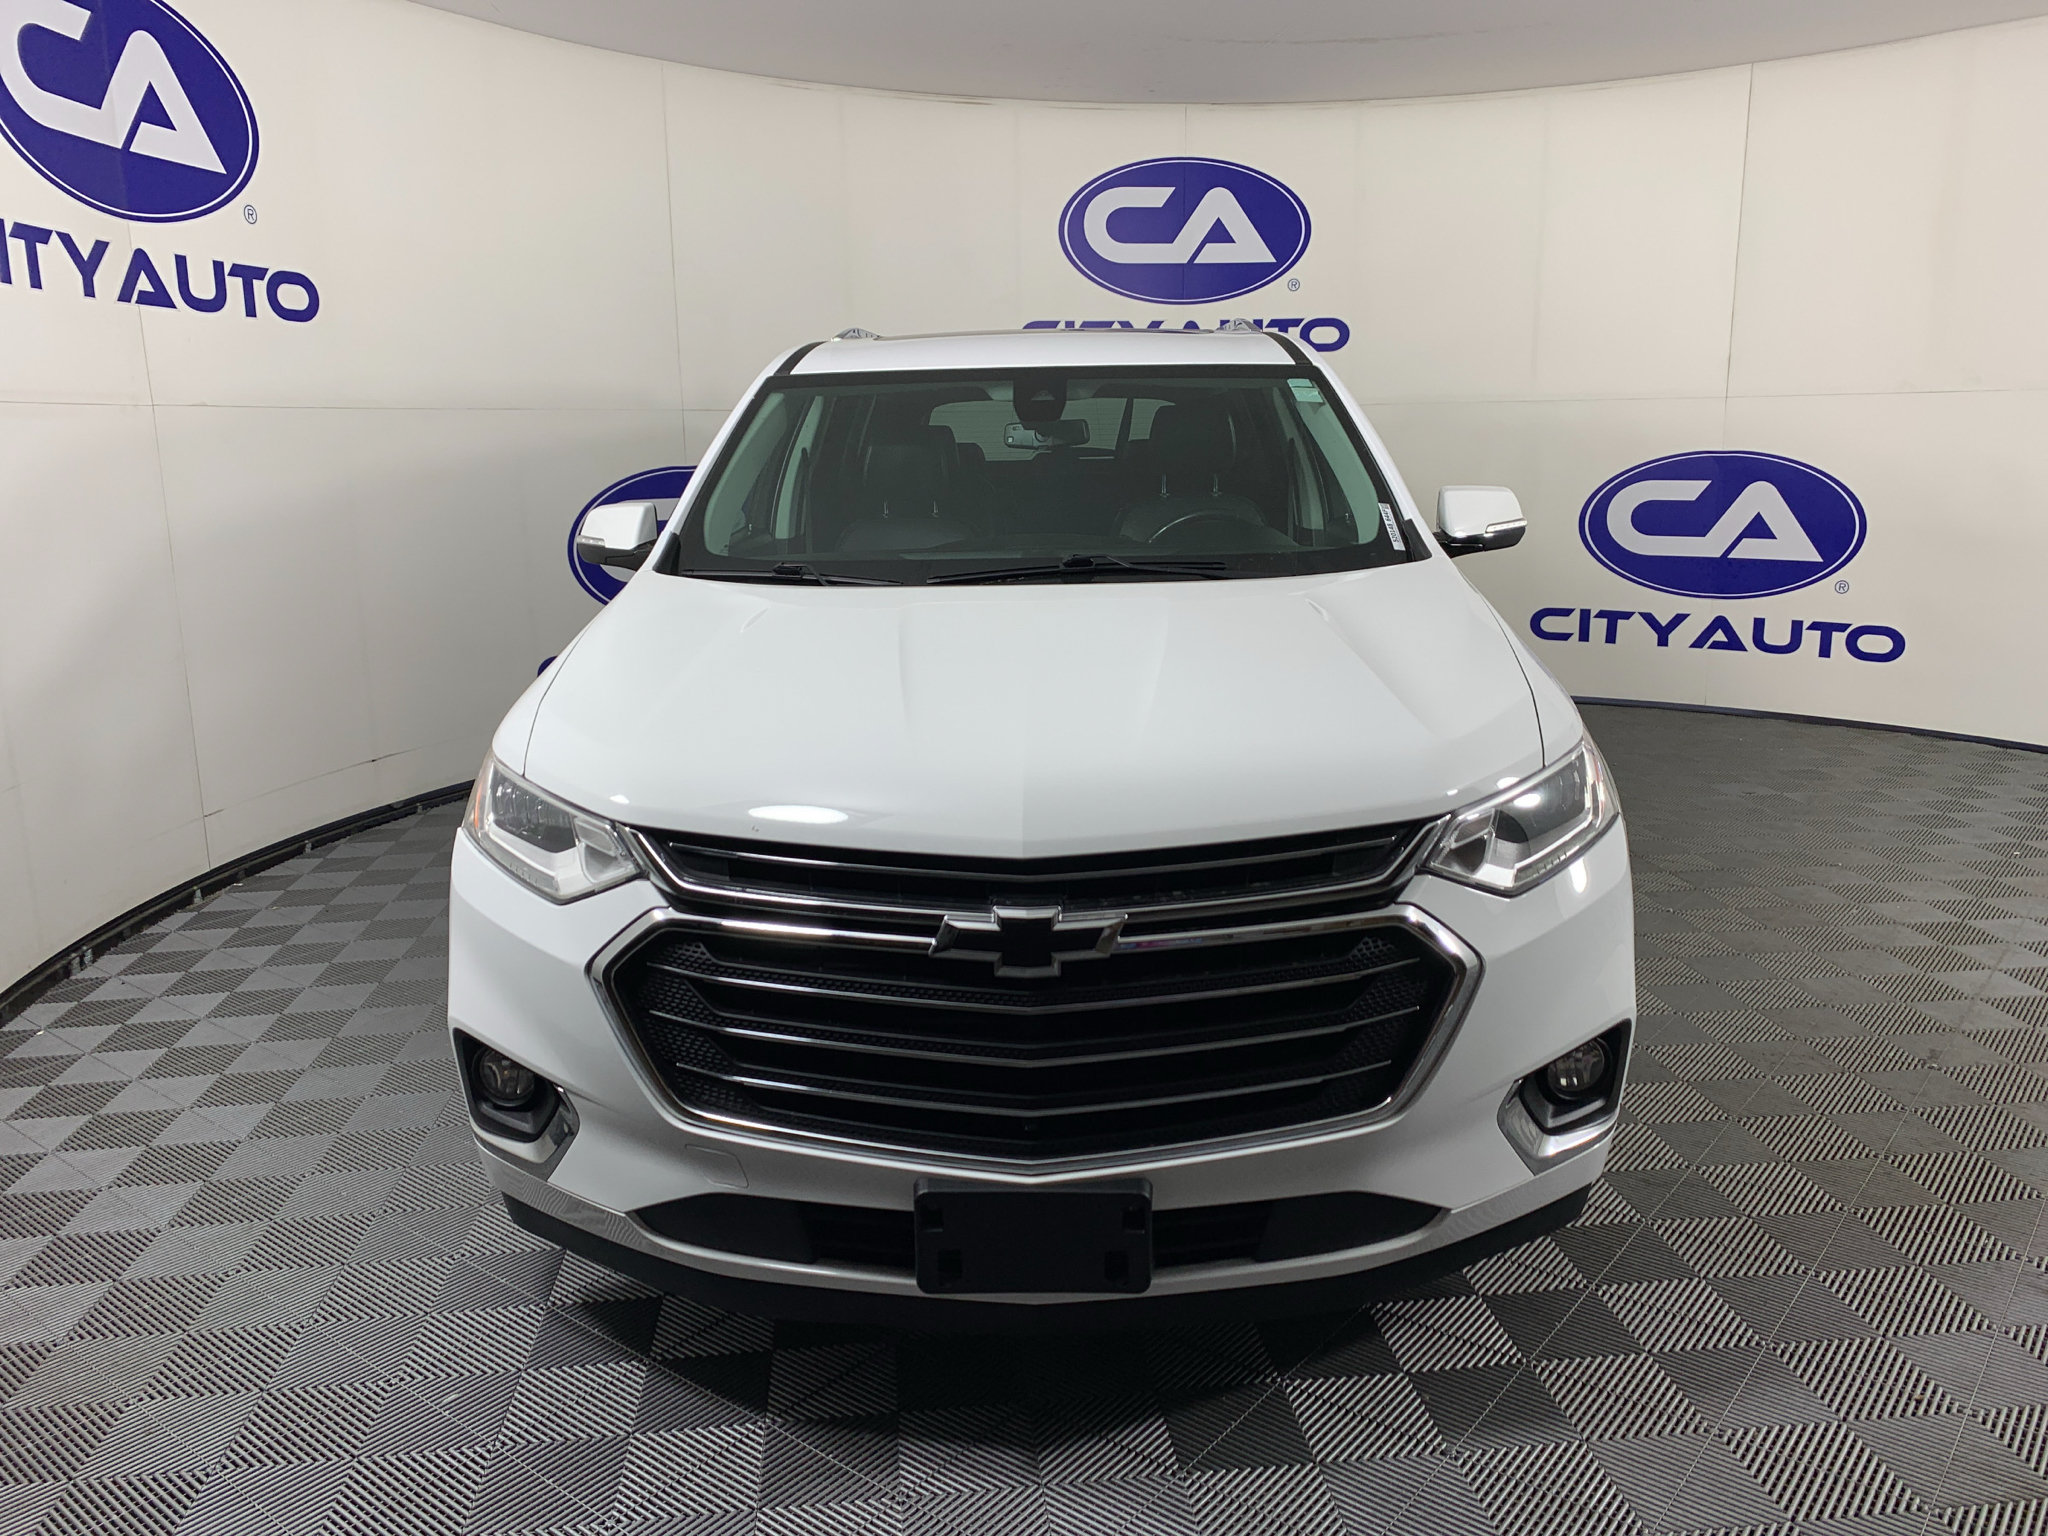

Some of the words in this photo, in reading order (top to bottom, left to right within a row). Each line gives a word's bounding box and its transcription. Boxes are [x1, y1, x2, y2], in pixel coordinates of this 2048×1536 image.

[0, 0, 228, 175] CA
[1083, 186, 1277, 264] CA
[116, 247, 320, 323] AUTO
[1606, 479, 1825, 563] CA
[1529, 607, 1692, 648] CITY
[1687, 614, 1907, 663] AUTO
